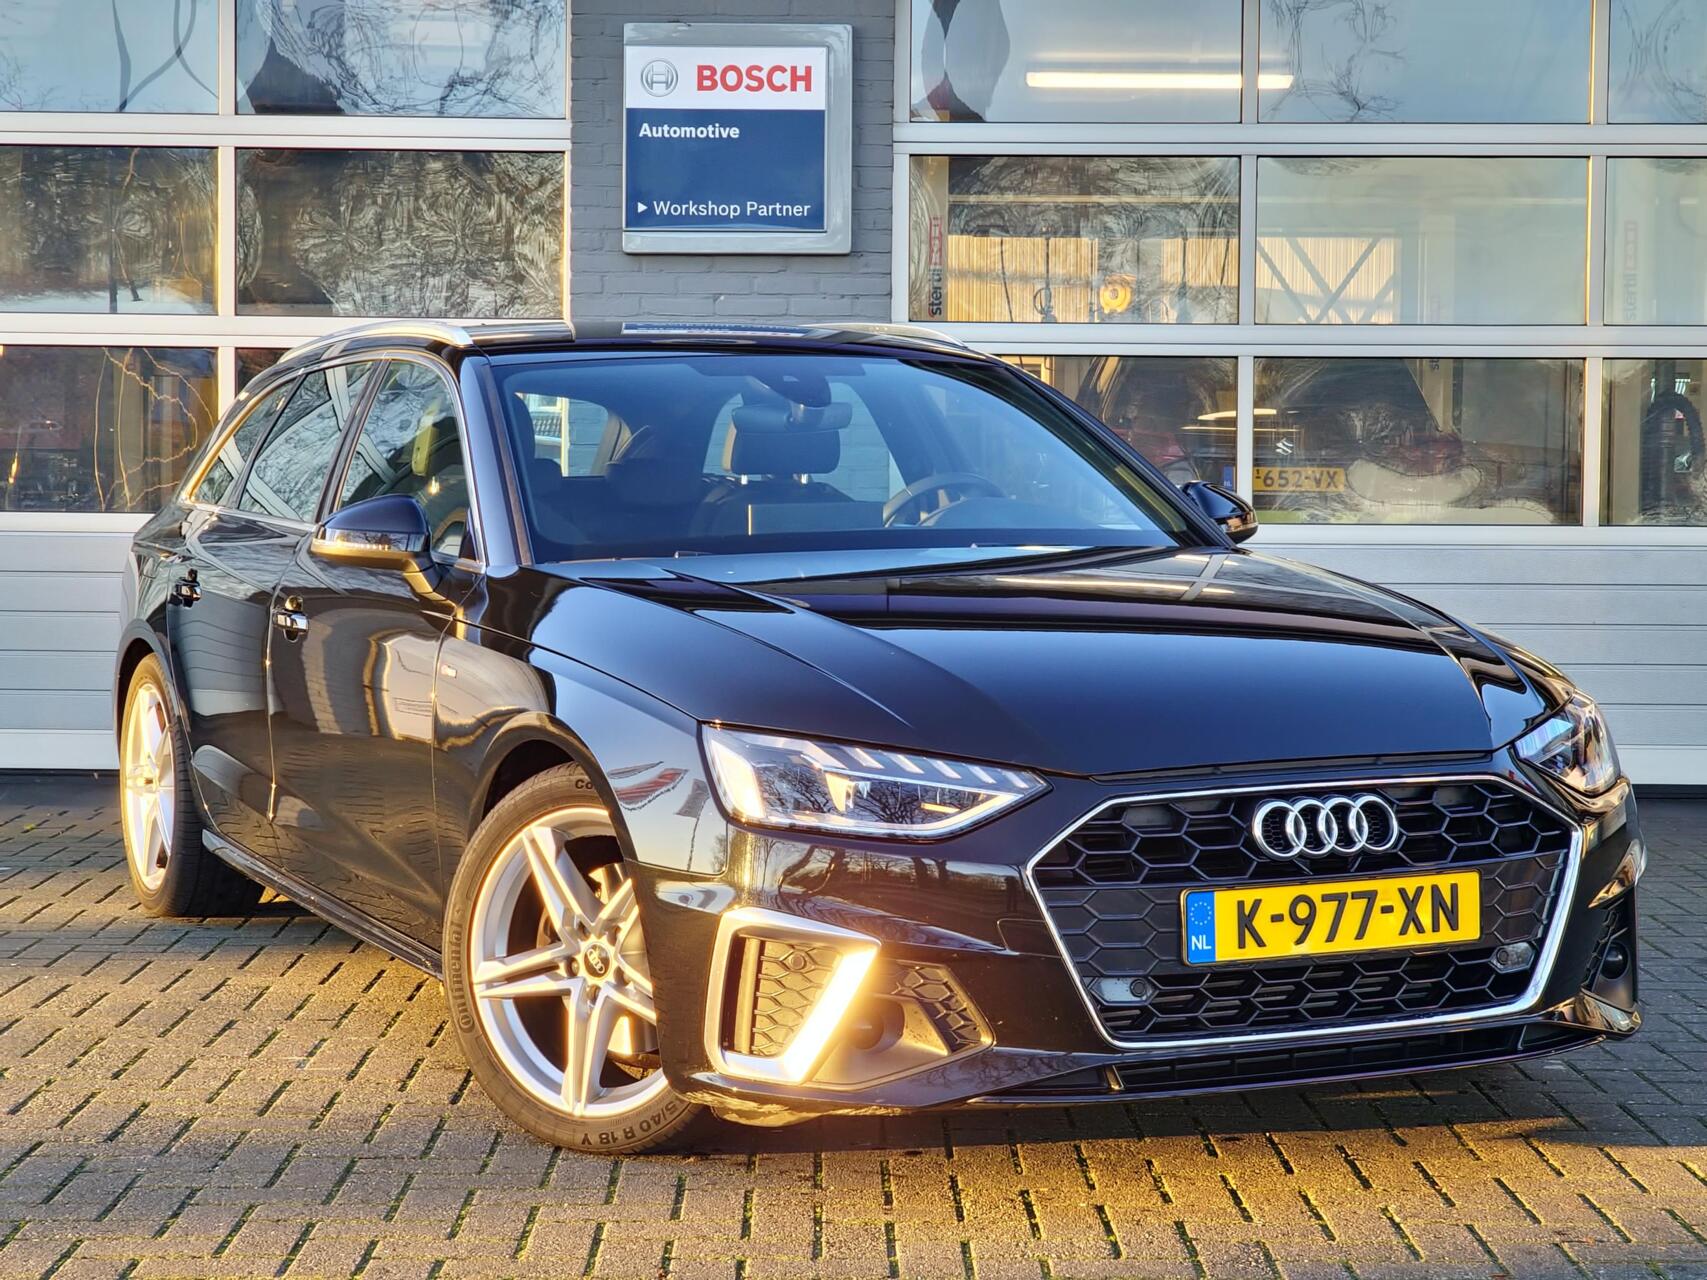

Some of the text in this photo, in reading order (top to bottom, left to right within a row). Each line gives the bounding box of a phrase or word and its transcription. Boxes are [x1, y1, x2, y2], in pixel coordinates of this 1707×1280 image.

[696, 65, 813, 92] BOSCH
[639, 123, 741, 138] Automotive
[653, 201, 811, 218] Workshop Partner
[1237, 883, 1459, 949] K-977-XN
[1191, 934, 1211, 950] NL
[598, 1131, 618, 1145] 18
